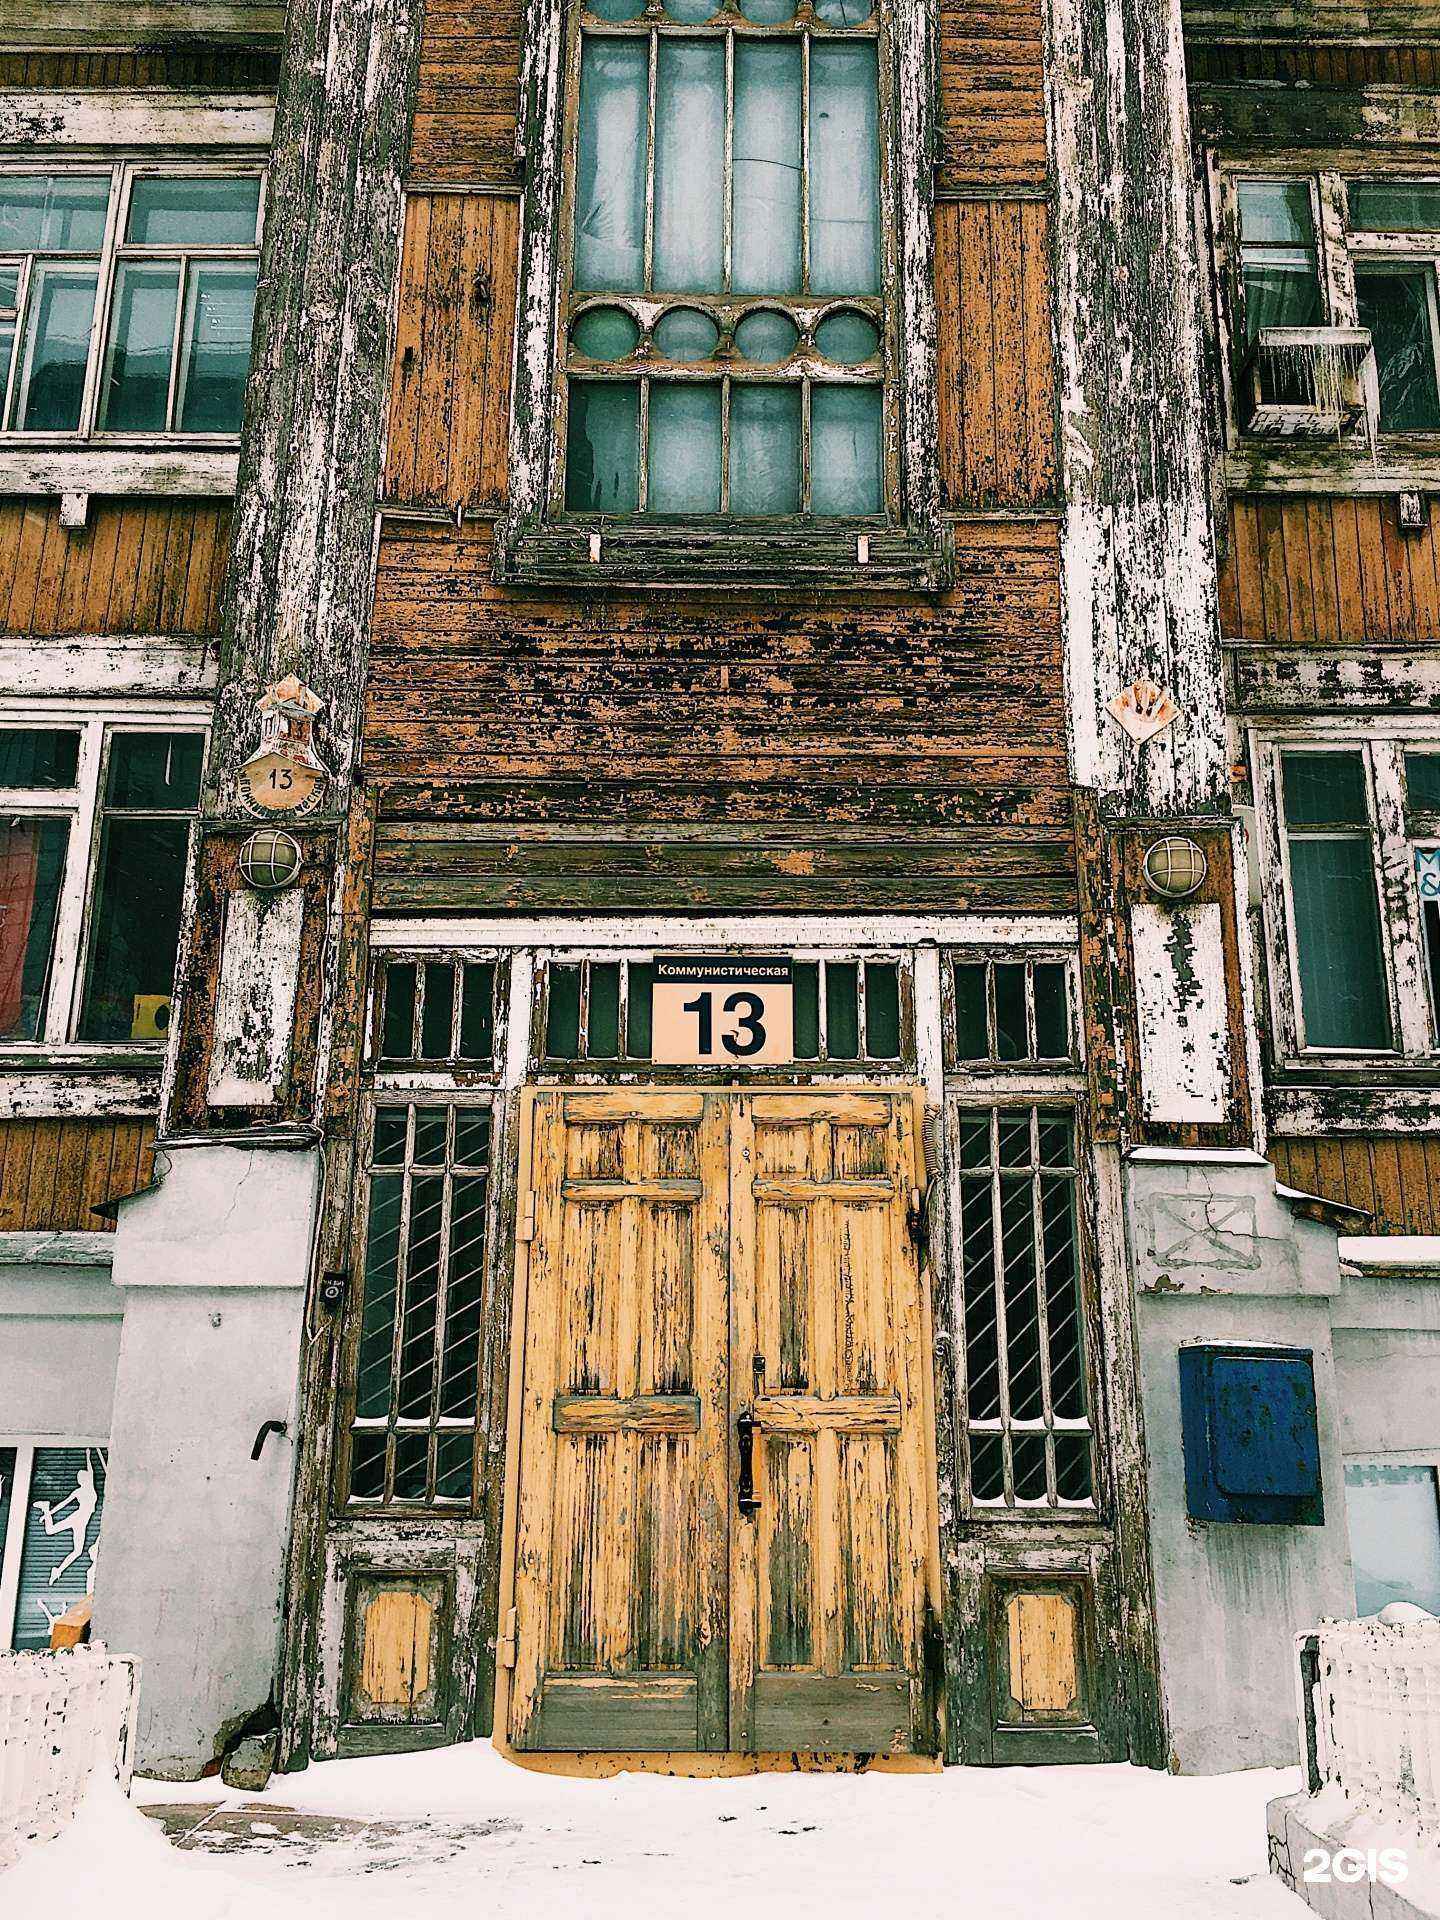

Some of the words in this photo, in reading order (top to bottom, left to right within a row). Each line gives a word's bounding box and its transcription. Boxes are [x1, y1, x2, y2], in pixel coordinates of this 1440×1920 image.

[269, 768, 293, 790] 13
[658, 964, 789, 978] Коммунистическая
[684, 992, 766, 1056] 13
